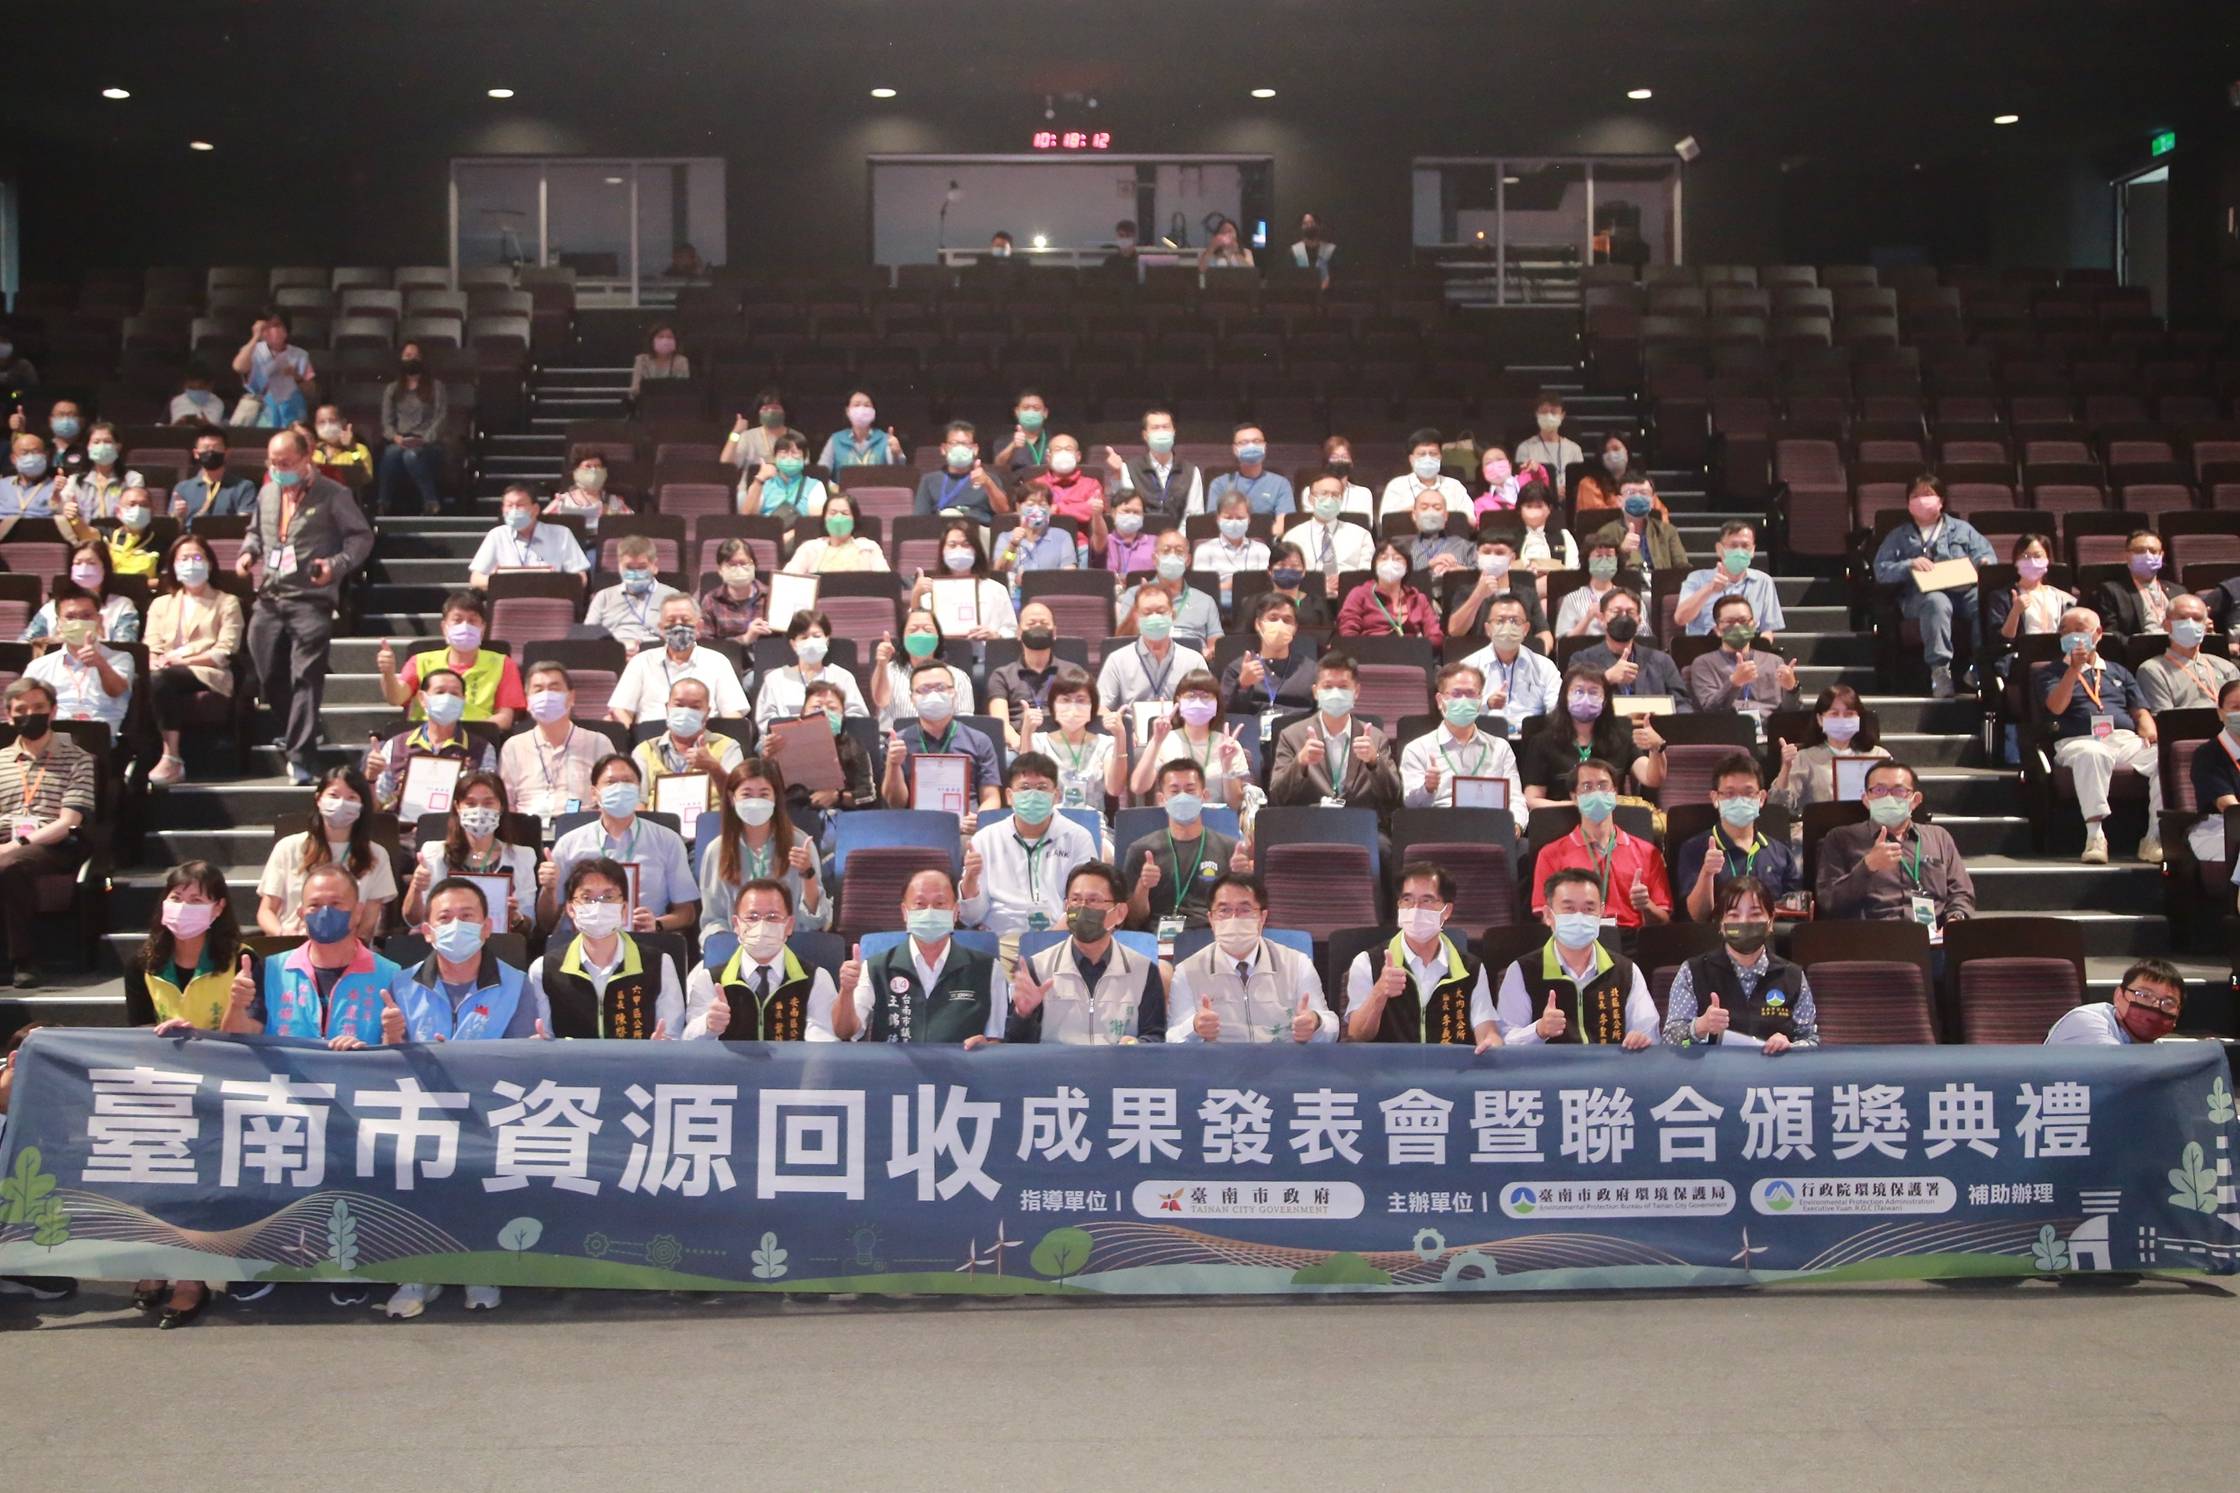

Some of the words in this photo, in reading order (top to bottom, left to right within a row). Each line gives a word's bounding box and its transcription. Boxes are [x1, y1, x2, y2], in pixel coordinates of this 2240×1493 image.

[900, 993, 912, 1042] 台南市議
[81, 1066, 1003, 1202] 臺南市資源回收
[1016, 1081, 2093, 1166] 成果發表會暨聯合頒獎典禮
[1190, 1187, 1330, 1204] 臺南市政府
[1539, 1186, 1726, 1203] 臺南市政府環境保護局
[1801, 1181, 1940, 1197] 行政院環境保護署
[1968, 1183, 2055, 1206] 補助辦理
[1020, 1189, 1108, 1212] 指導單位
[1191, 1205, 1230, 1214] TAINAN
[1232, 1205, 1256, 1214] CITY
[1259, 1205, 1329, 1214] GOVERNMENT
[1387, 1191, 1475, 1213] 主辦單位
